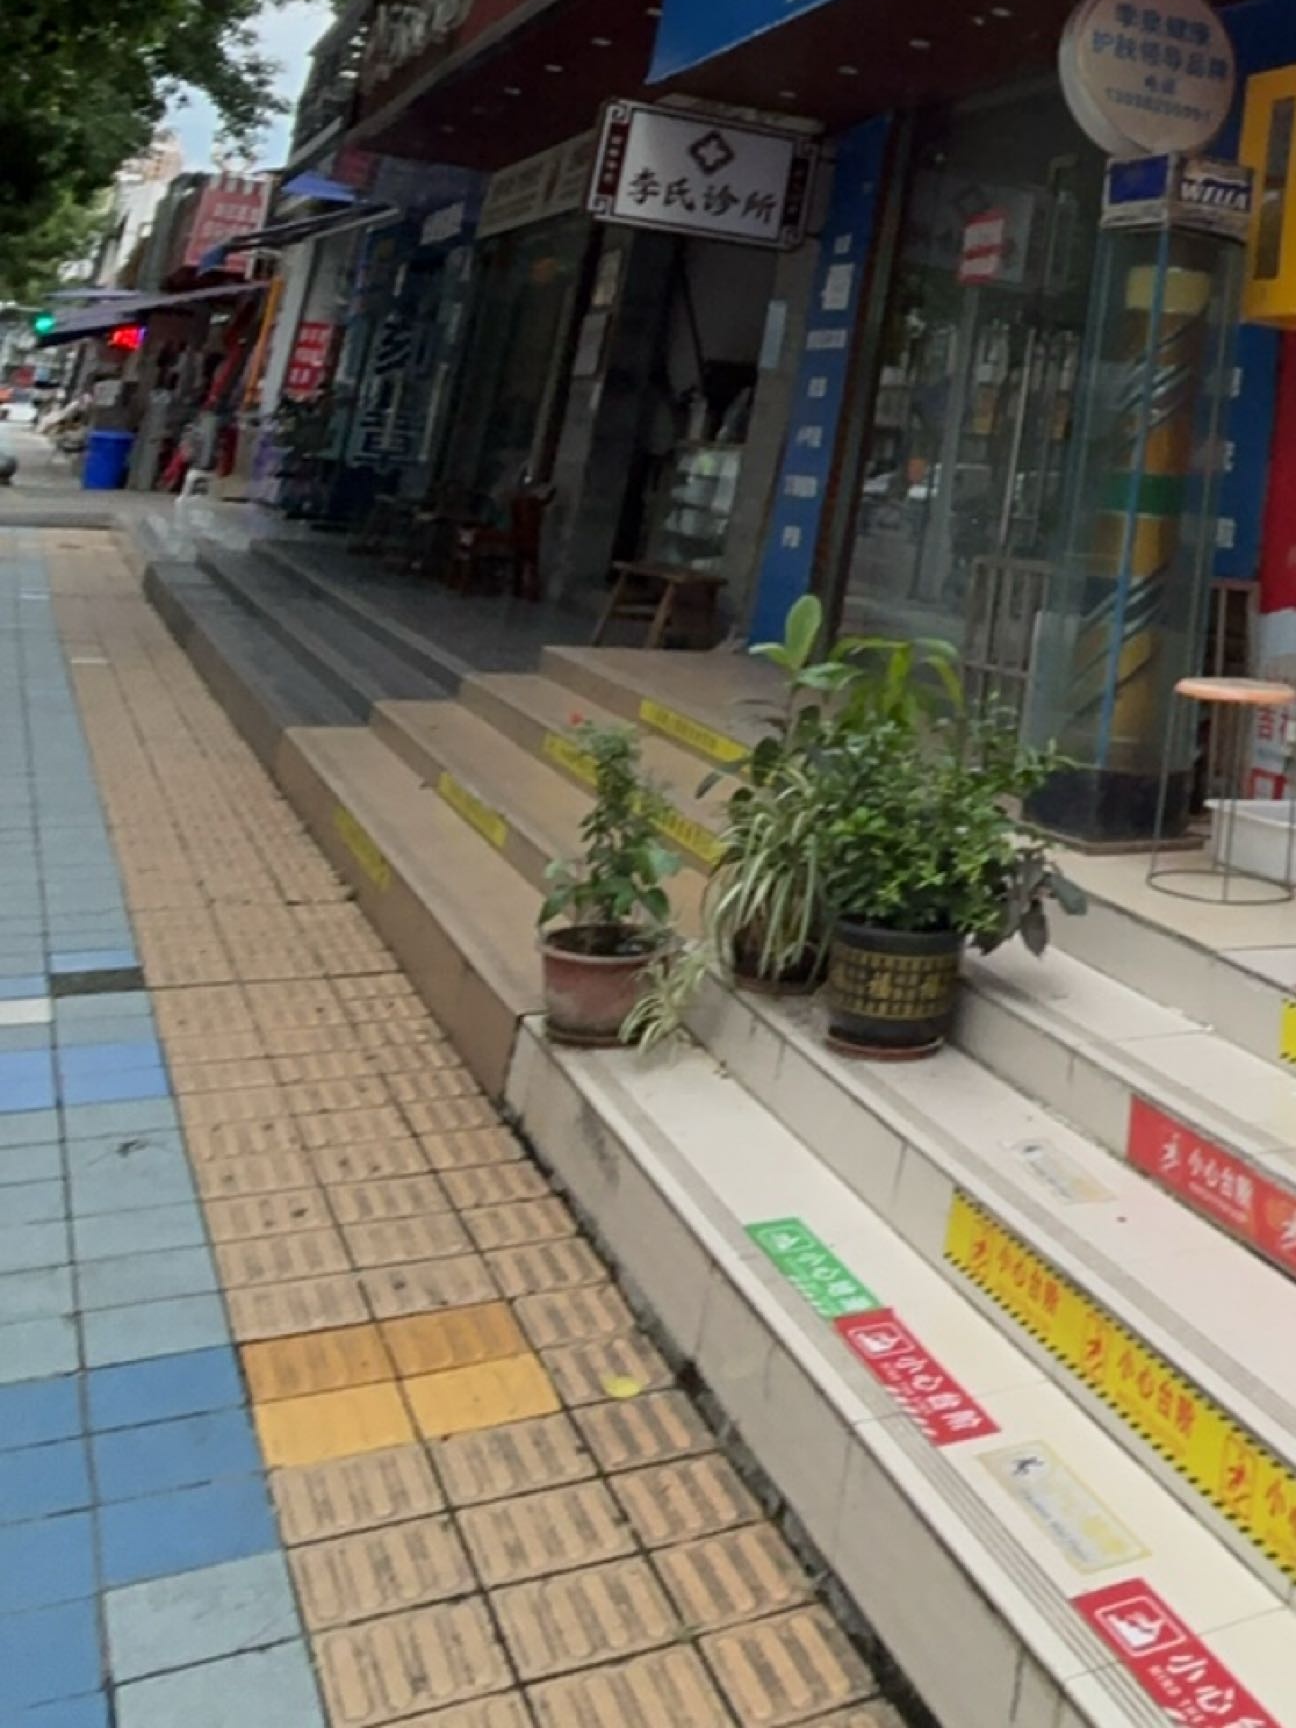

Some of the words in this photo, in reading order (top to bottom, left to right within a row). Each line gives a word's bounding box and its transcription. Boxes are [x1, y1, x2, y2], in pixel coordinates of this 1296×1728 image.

[627, 167, 777, 224] 李氏诊所
[1188, 1148, 1254, 1209] 小心台阶
[1119, 1350, 1197, 1439] 小心台阶
[1166, 1654, 1266, 1728] 小心
